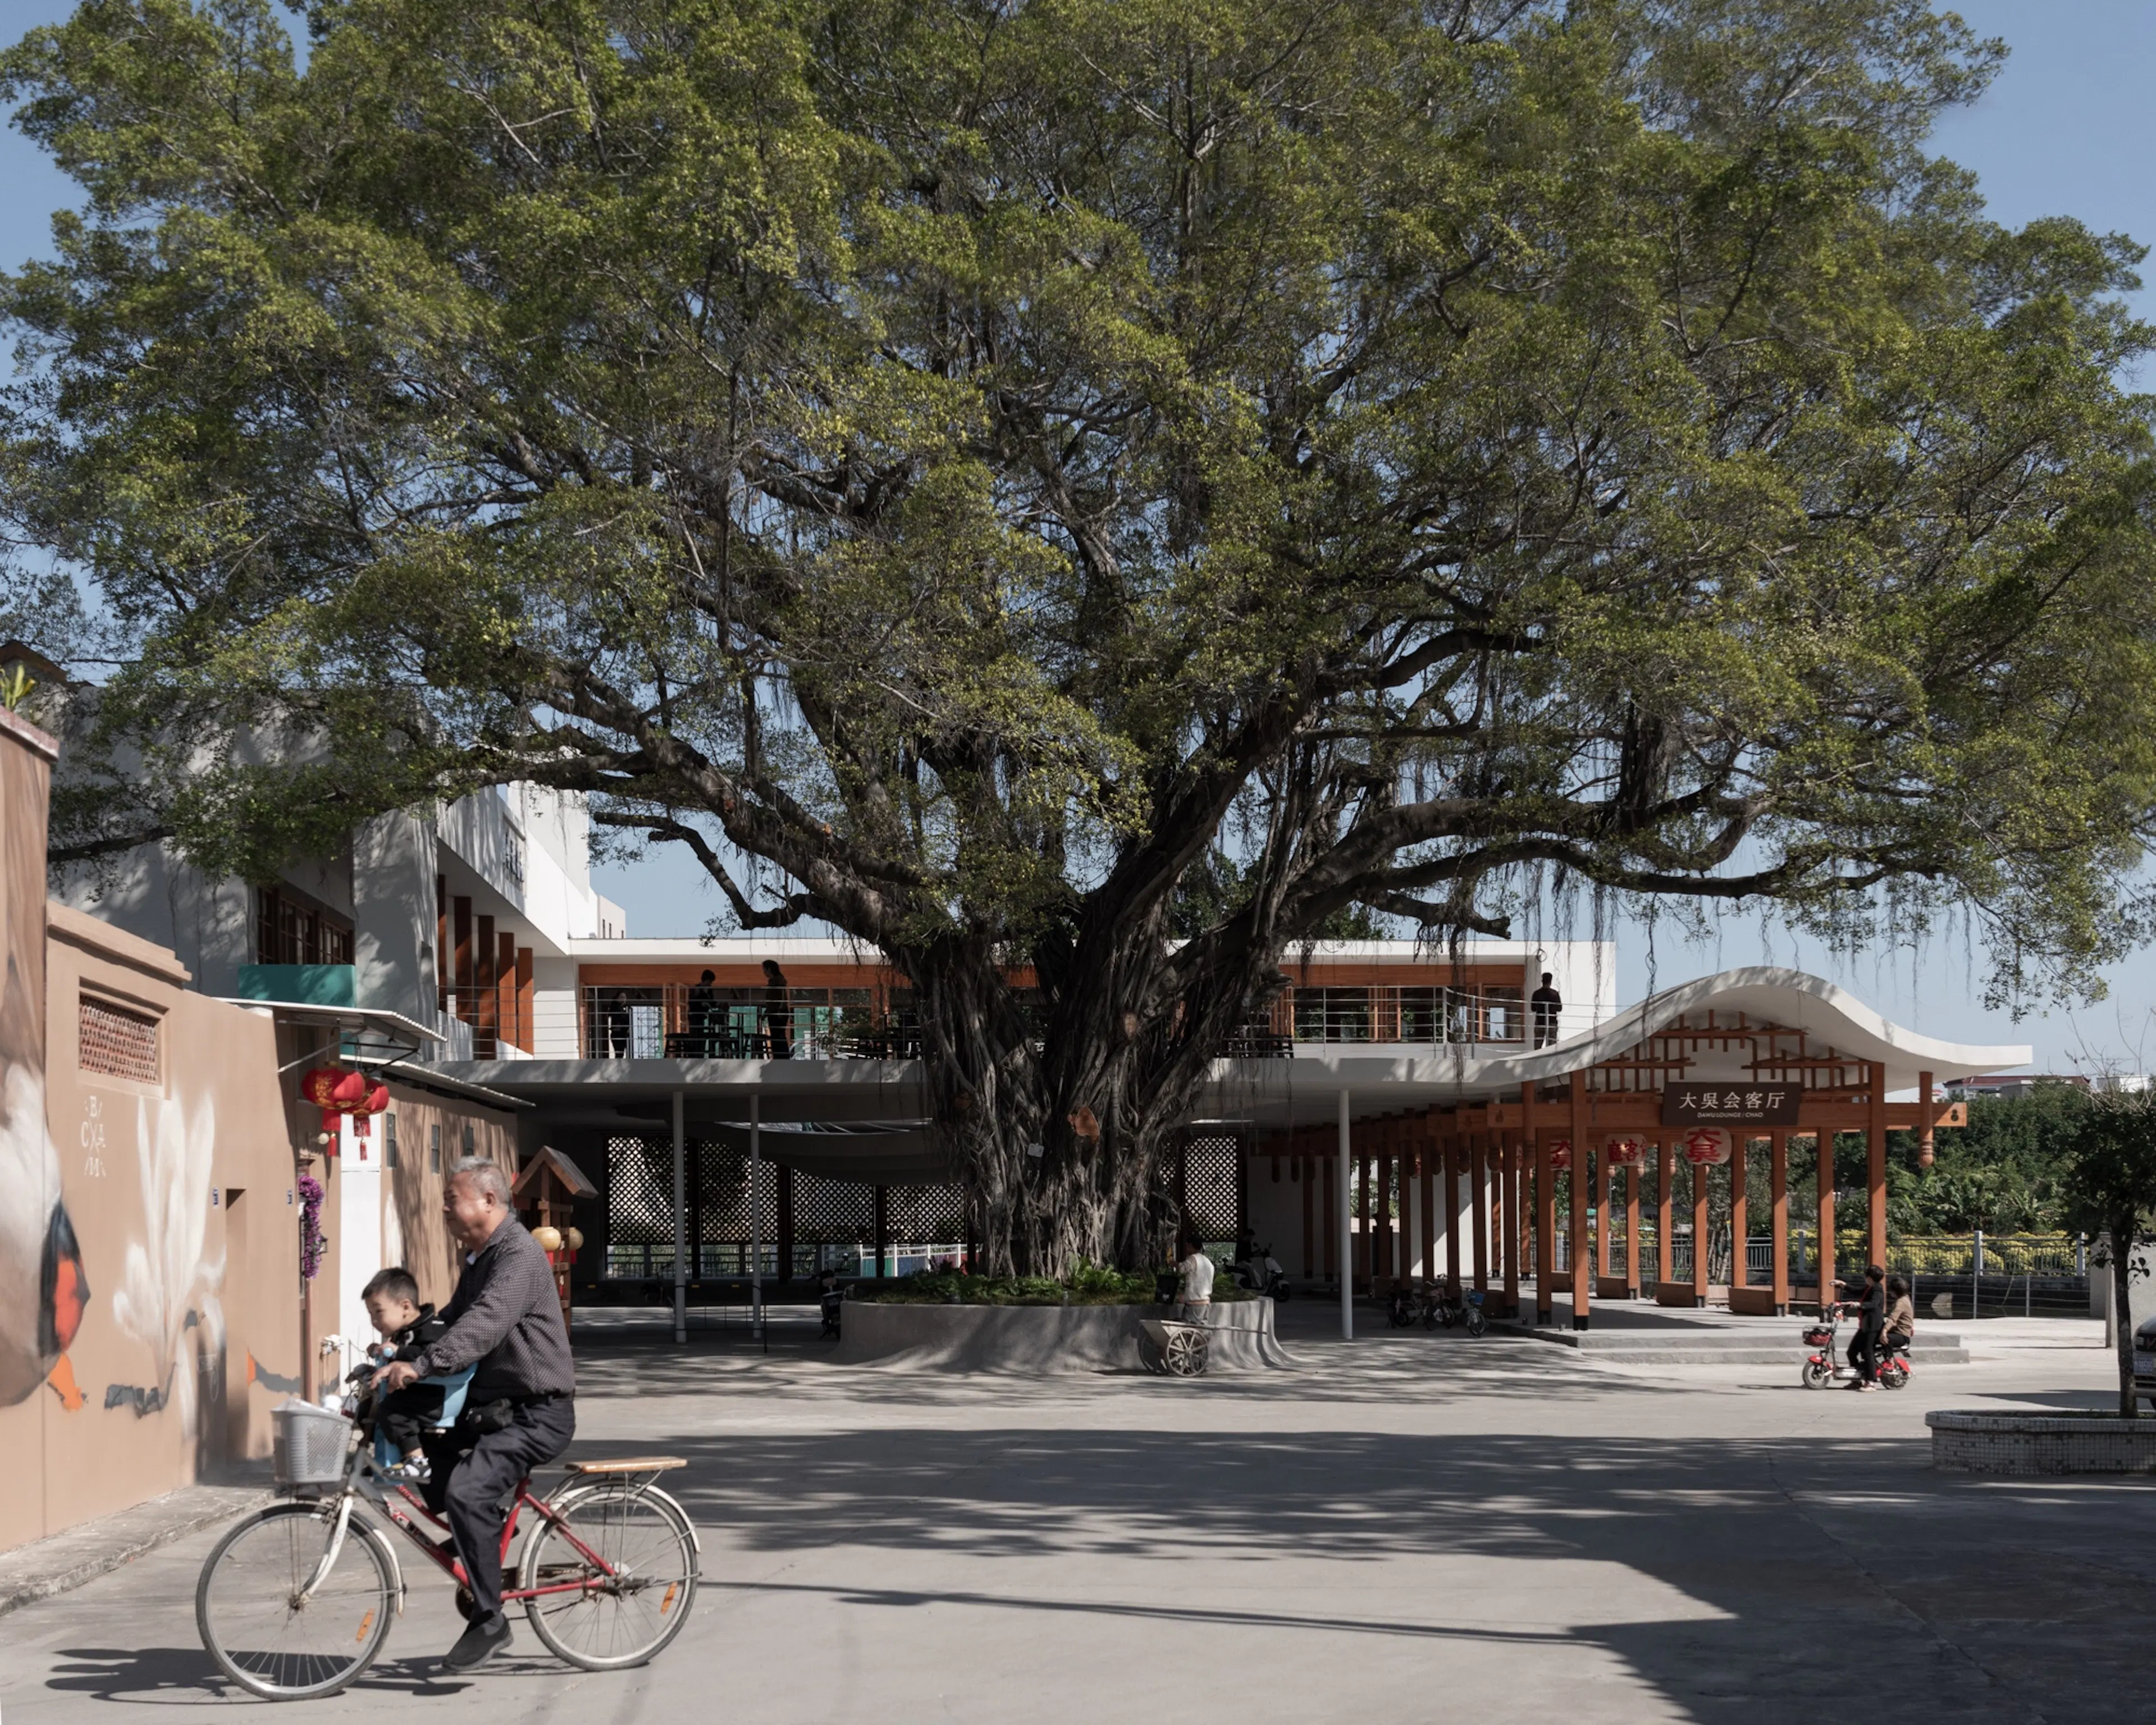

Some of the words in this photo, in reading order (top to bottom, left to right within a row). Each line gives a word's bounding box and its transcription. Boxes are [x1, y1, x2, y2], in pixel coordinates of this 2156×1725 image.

[1679, 1092, 1785, 1110] 大吳会客厅
